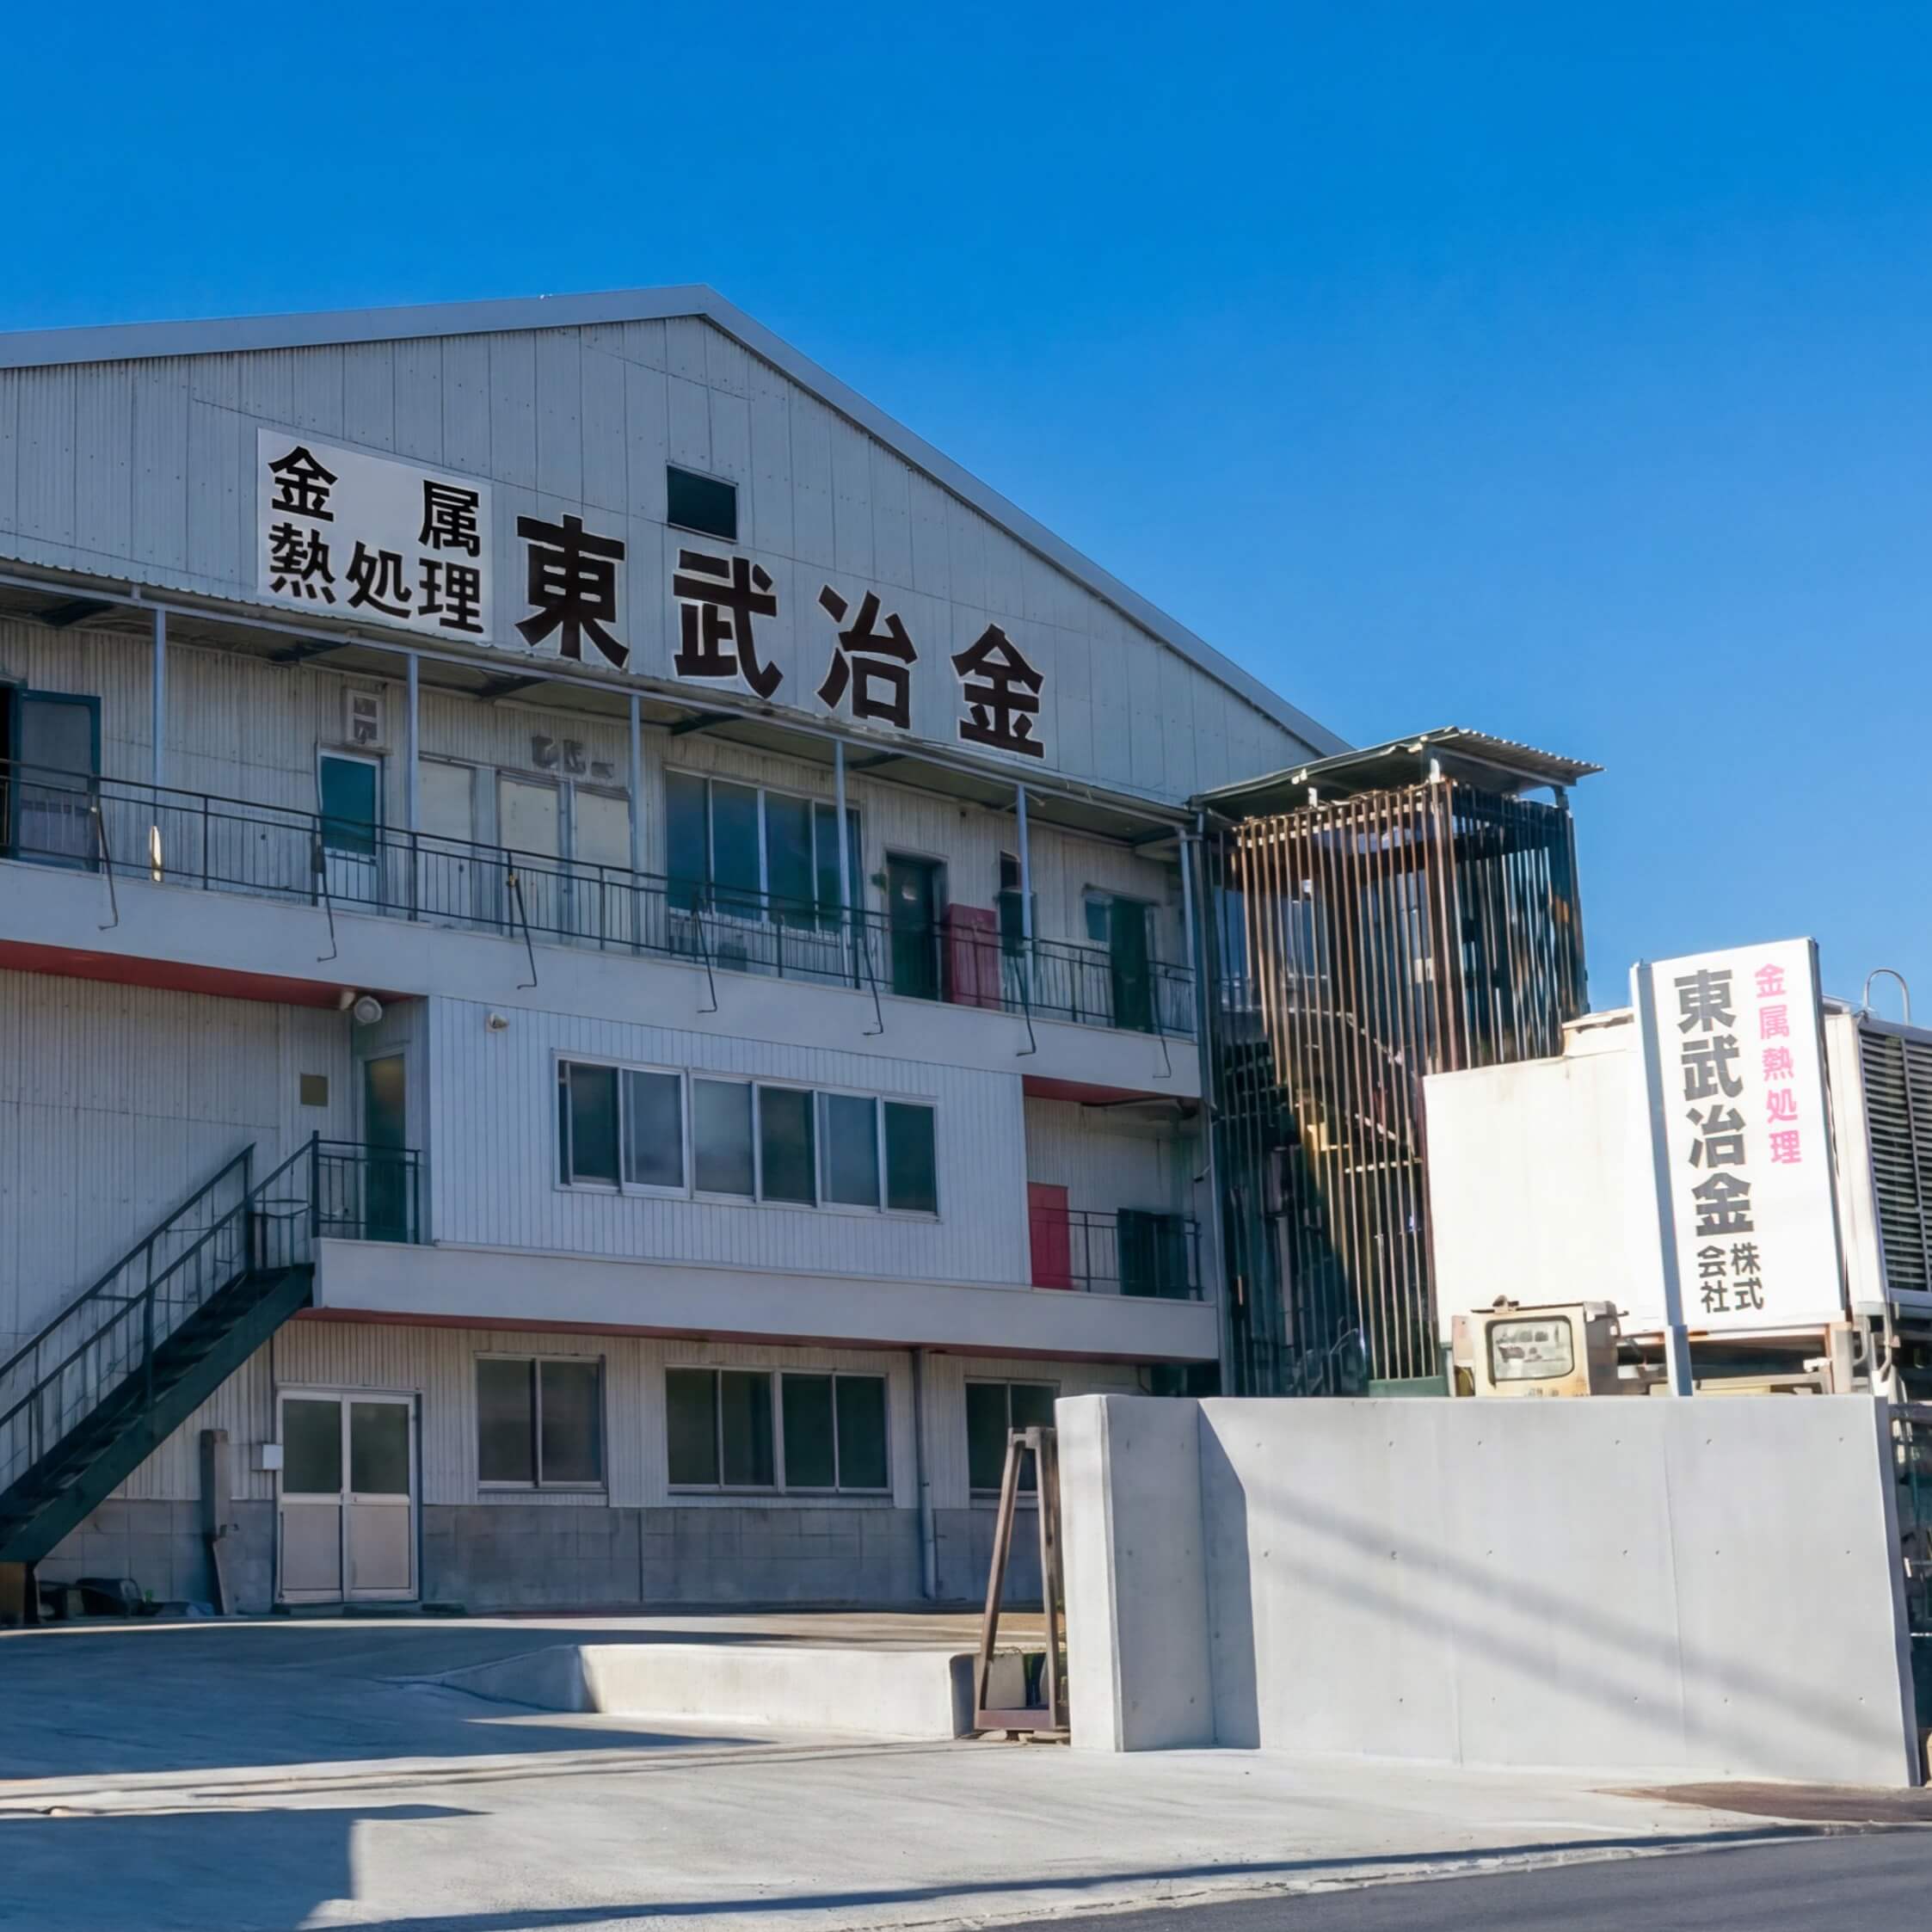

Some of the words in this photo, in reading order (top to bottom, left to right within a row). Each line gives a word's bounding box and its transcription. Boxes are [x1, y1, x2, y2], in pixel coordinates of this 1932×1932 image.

[268, 521, 483, 634] 熱処理
[515, 514, 1045, 759] 東武冶金
[1674, 969, 1755, 1237] 東武冶金
[1754, 963, 1802, 1164] 金属熱処理
